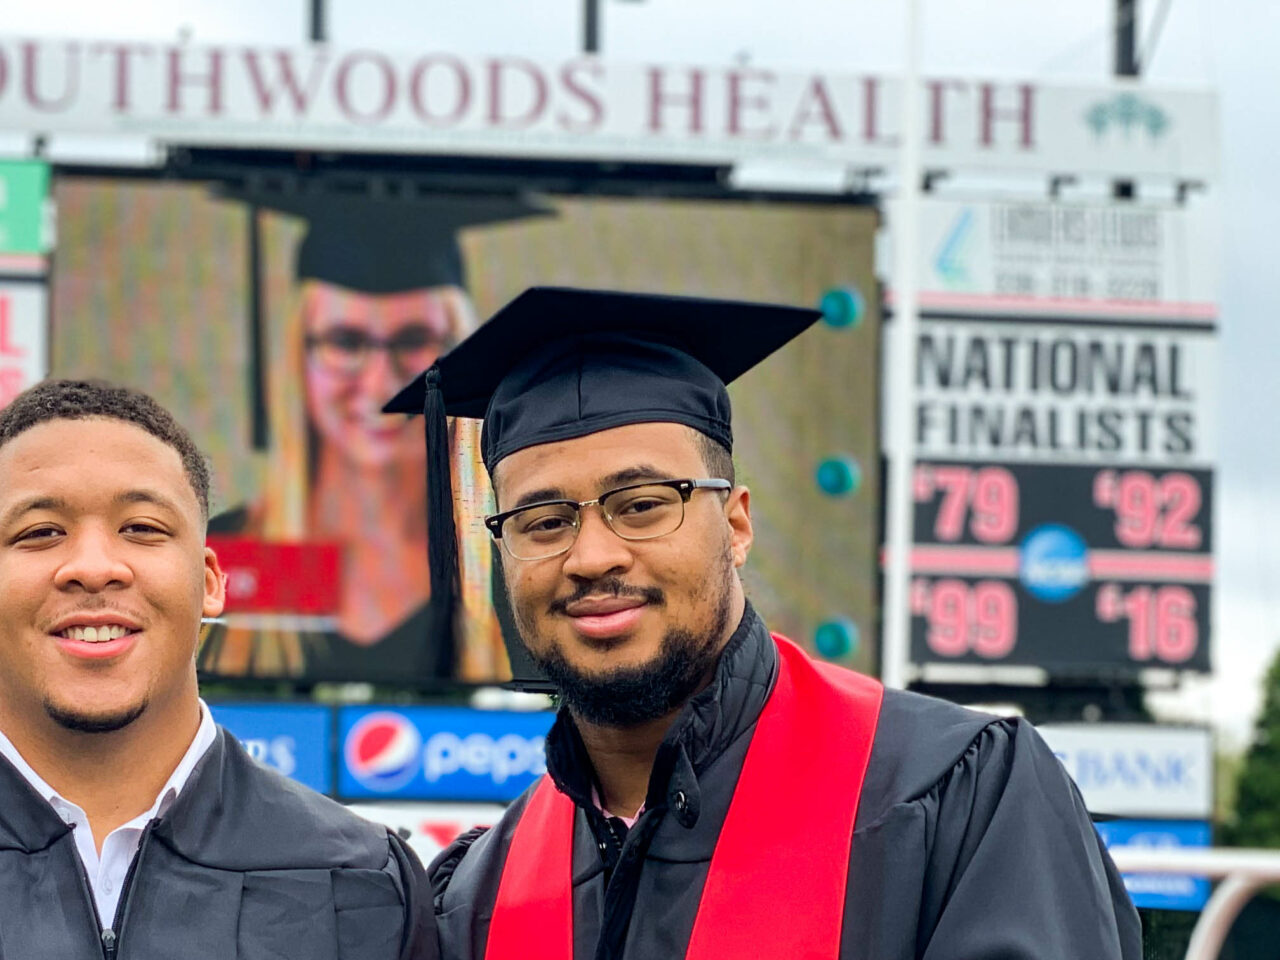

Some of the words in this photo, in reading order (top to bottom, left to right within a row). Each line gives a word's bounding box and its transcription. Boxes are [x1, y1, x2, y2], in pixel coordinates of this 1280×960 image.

[644, 64, 1037, 151] HEALTH
[916, 335, 1191, 399] NATIONAL
[916, 402, 1194, 454] FINALISTS
[423, 732, 547, 784] peps
